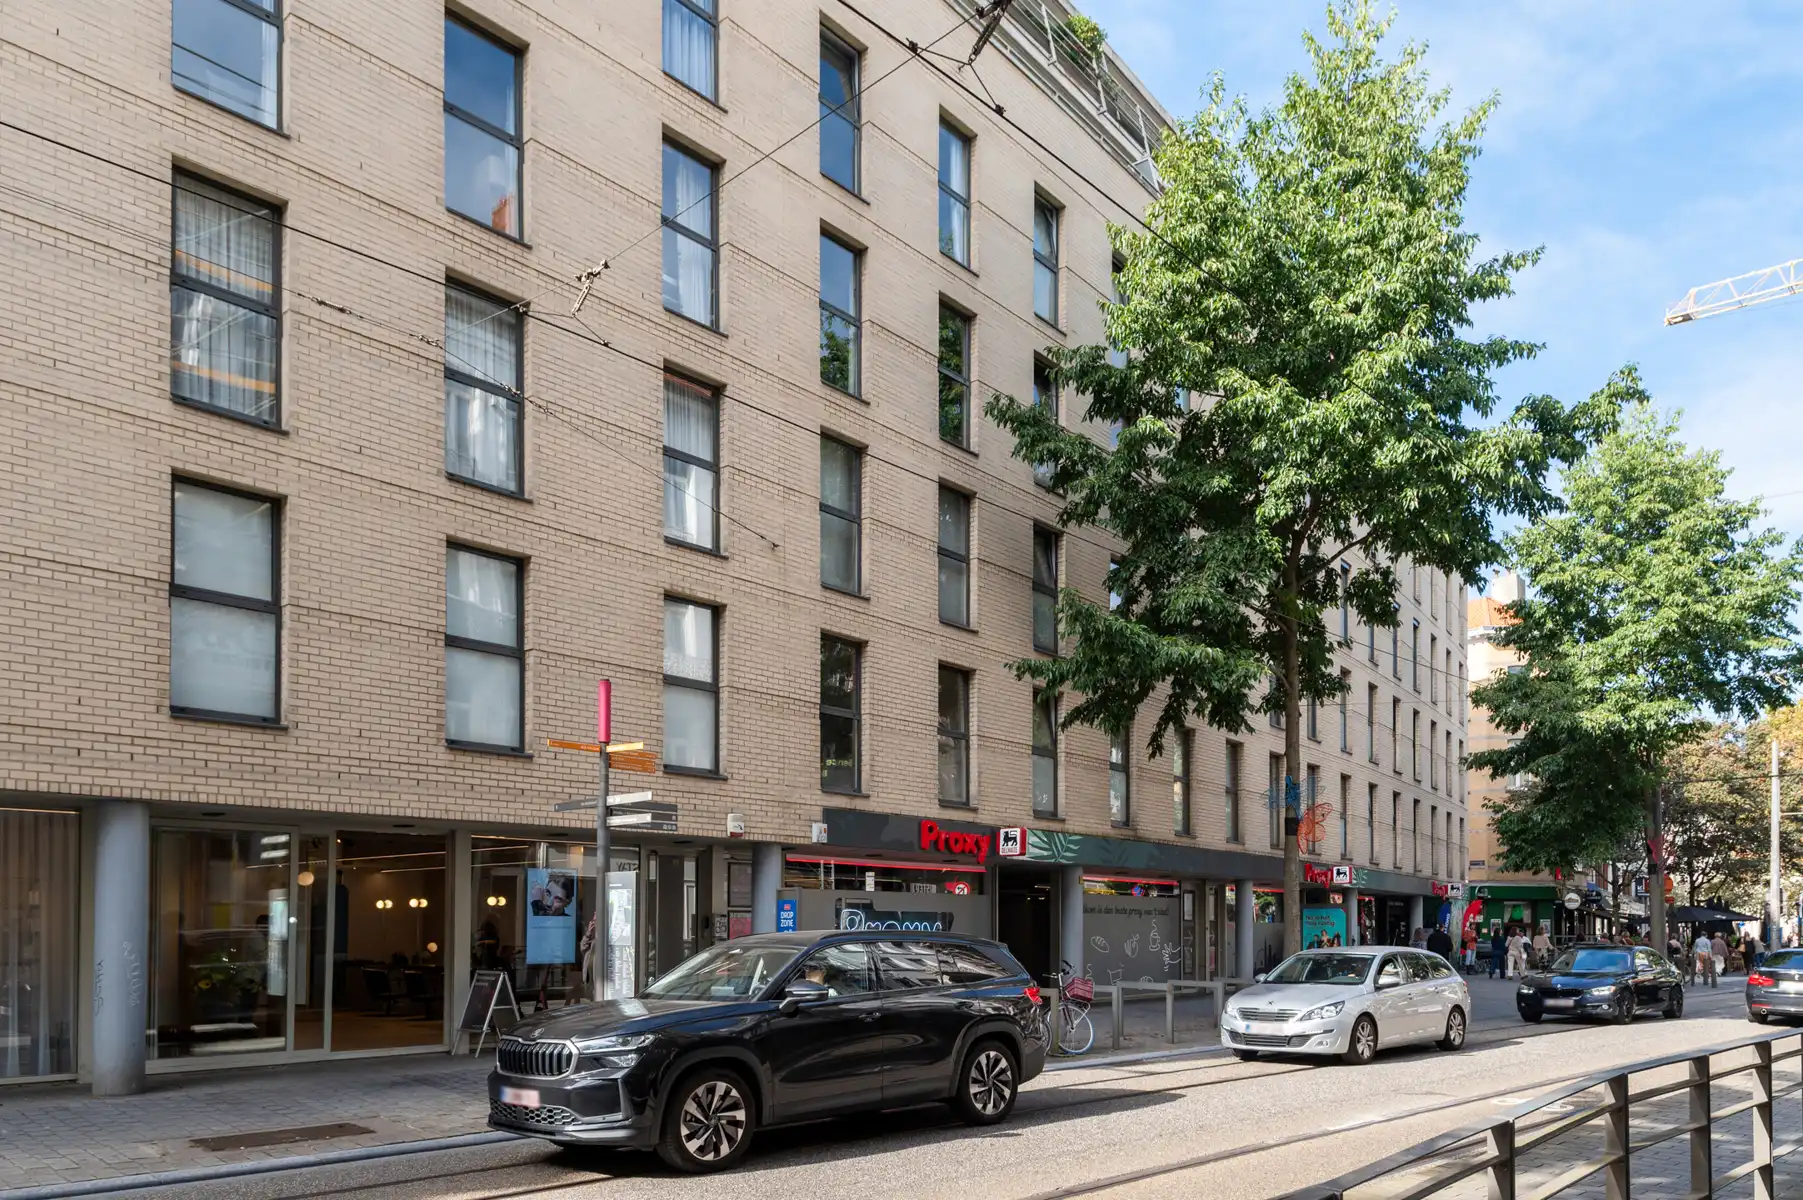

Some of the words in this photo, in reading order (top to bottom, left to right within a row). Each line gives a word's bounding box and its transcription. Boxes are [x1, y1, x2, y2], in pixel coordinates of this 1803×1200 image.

[920, 819, 991, 864] Proxy
[780, 911, 794, 919] DROP
[780, 919, 794, 927] ZONE
